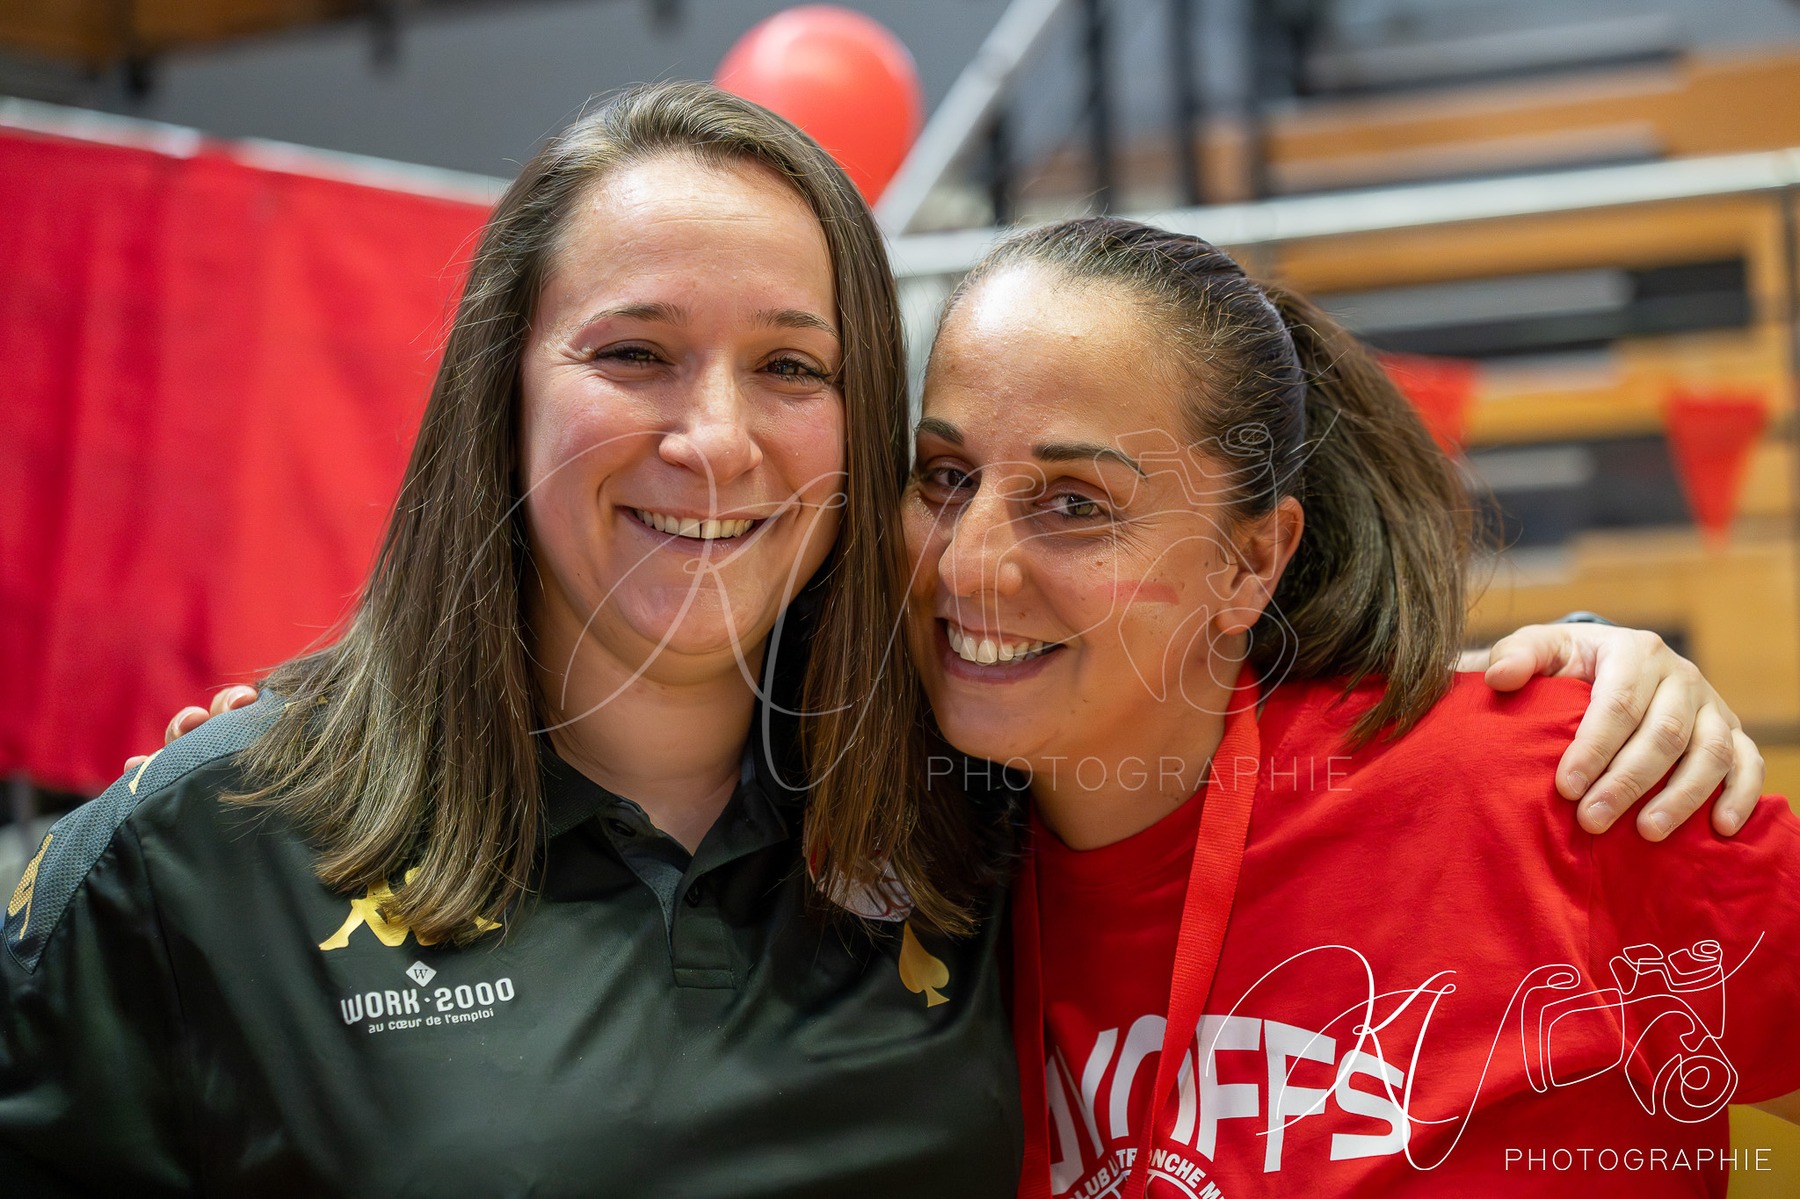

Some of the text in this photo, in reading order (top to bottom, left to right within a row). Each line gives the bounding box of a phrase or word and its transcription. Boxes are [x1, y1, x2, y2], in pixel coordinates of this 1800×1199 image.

[368, 1007, 494, 1034] au cœur de l'emploi
[1068, 1167, 1111, 1199] LUB
[1115, 1148, 1206, 1189] TRNCHE
